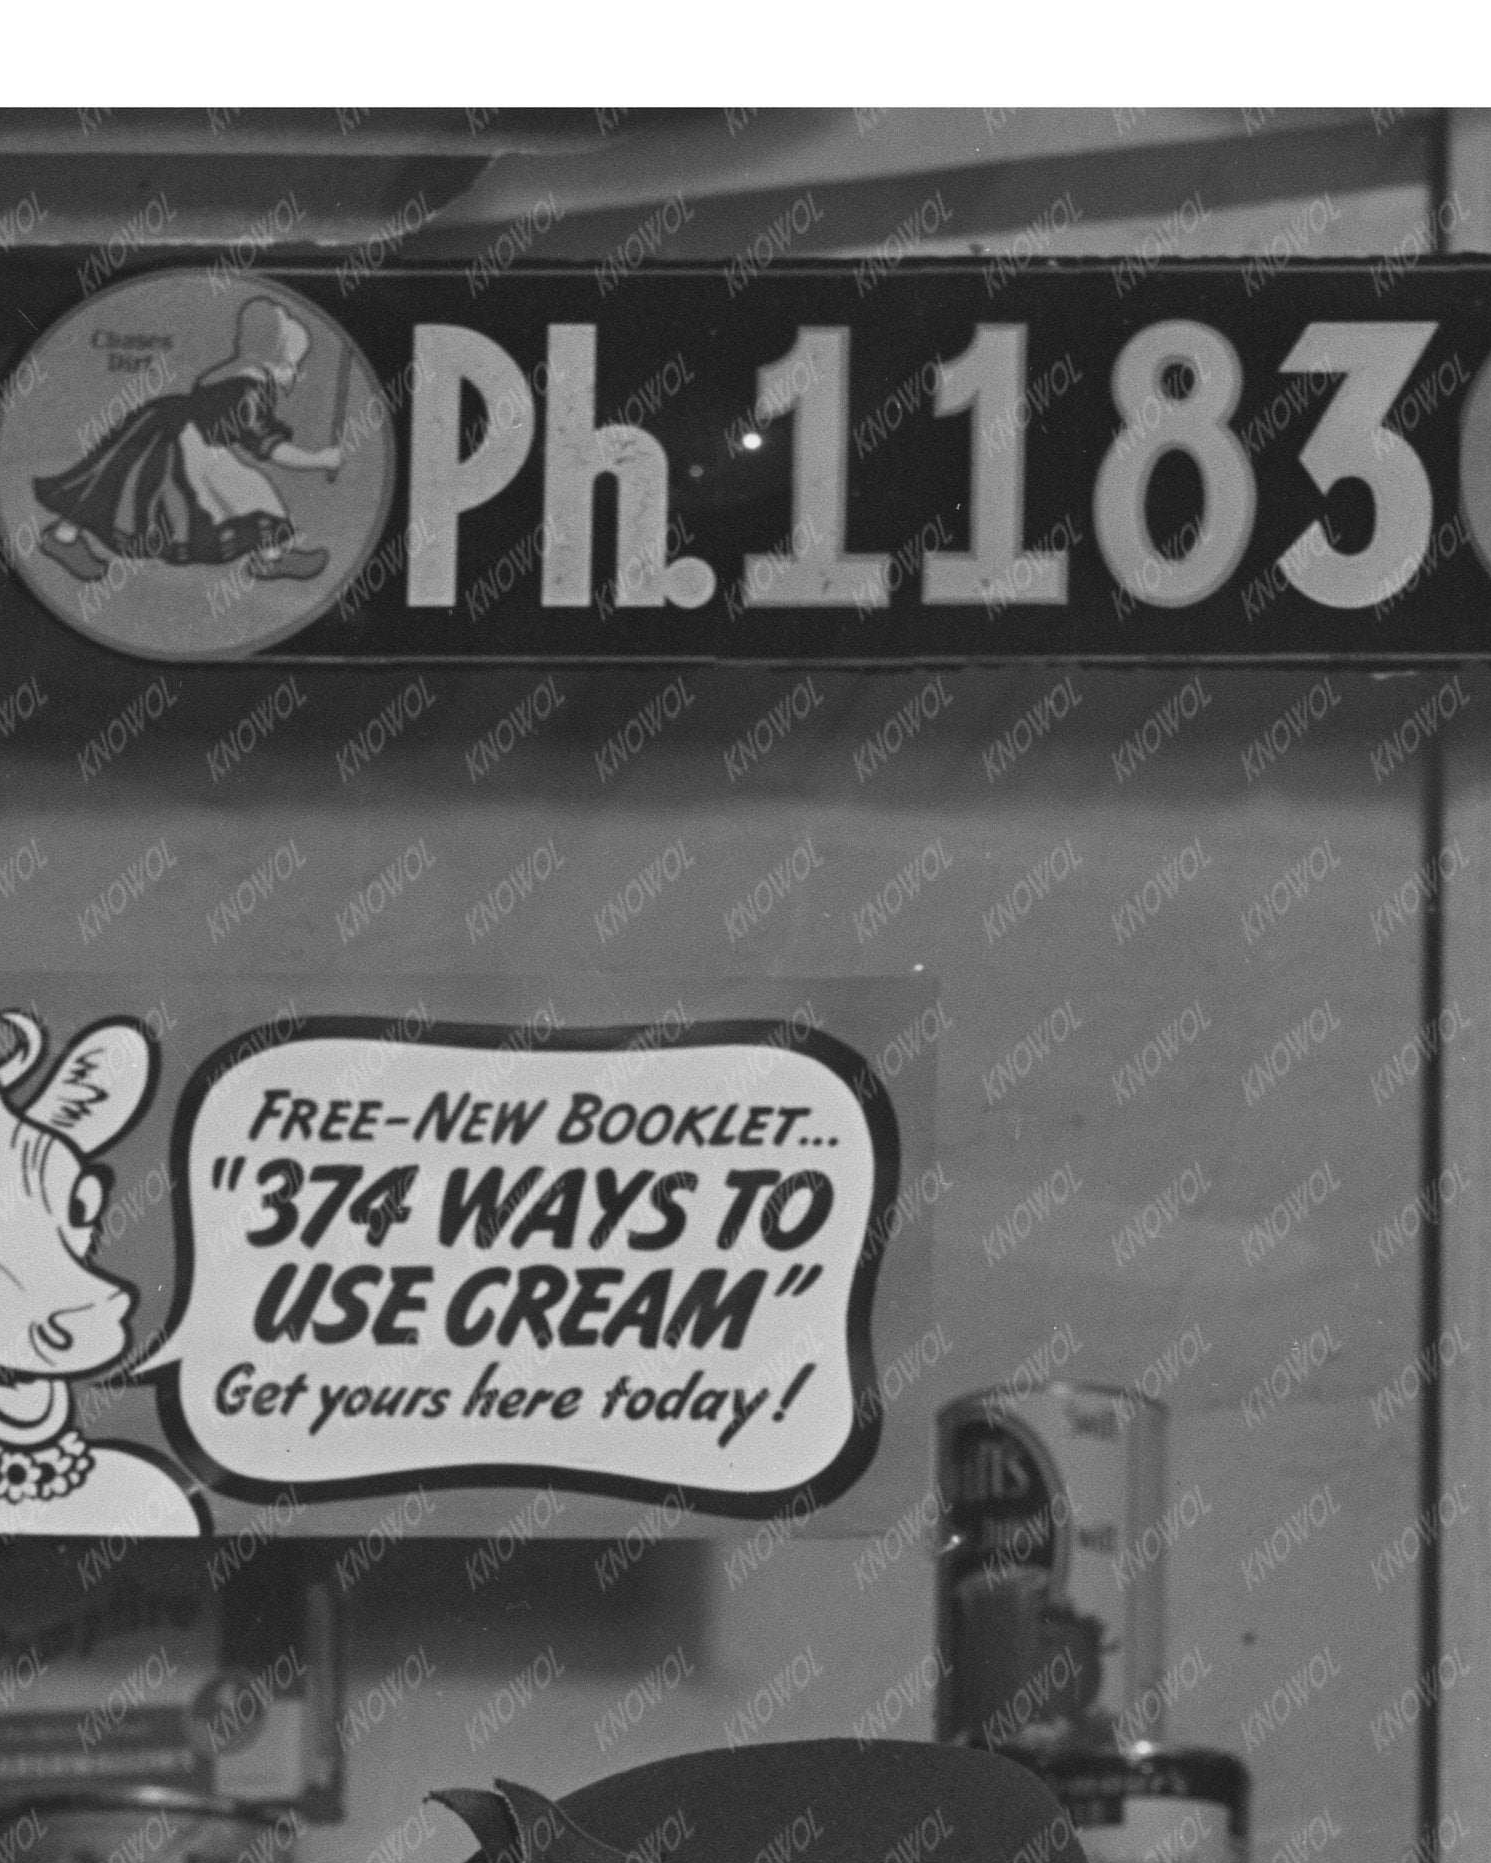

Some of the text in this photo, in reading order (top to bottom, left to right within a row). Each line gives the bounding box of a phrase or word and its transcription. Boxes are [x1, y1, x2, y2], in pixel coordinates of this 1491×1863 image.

[439, 1165, 696, 1252] WAYS
[716, 1168, 835, 1252] TO
[254, 1263, 823, 1350] USE CREAM"
[215, 1363, 309, 1418] Get
[307, 1383, 452, 1436] yours
[462, 1362, 584, 1421] here
